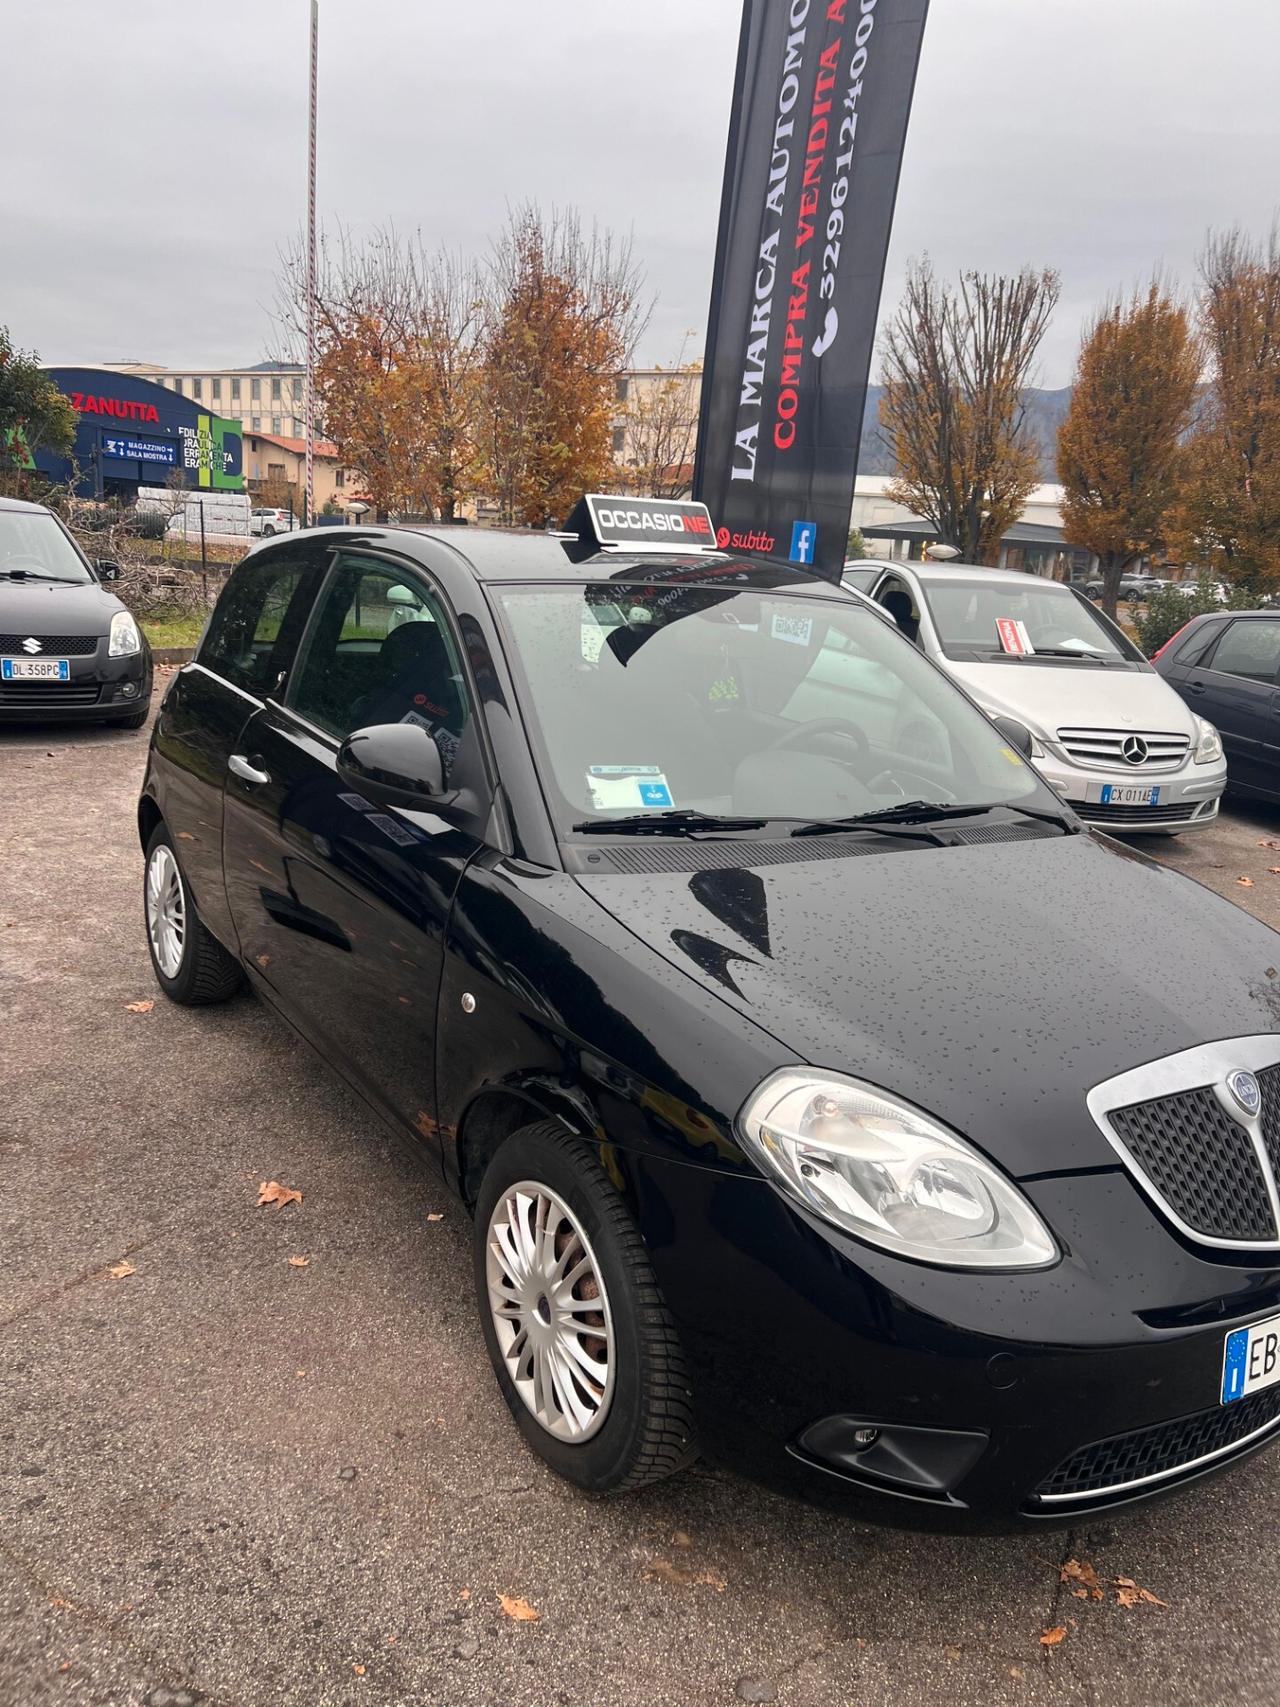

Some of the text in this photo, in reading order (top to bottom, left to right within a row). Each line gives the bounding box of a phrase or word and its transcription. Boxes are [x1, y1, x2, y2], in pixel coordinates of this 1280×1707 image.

[773, 259, 811, 450] COMPRA
[795, 36, 842, 250] VENDITA
[740, 228, 780, 407] MARCA
[71, 392, 160, 424] ZANUTTA
[126, 450, 168, 461] SALA MOSTRA
[128, 441, 167, 453] MAGAZZINO
[731, 422, 759, 483] LA
[598, 509, 711, 534] OCCASIONE
[732, 530, 776, 552] subito
[13, 663, 25, 676] DL
[1111, 788, 1123, 801] CX
